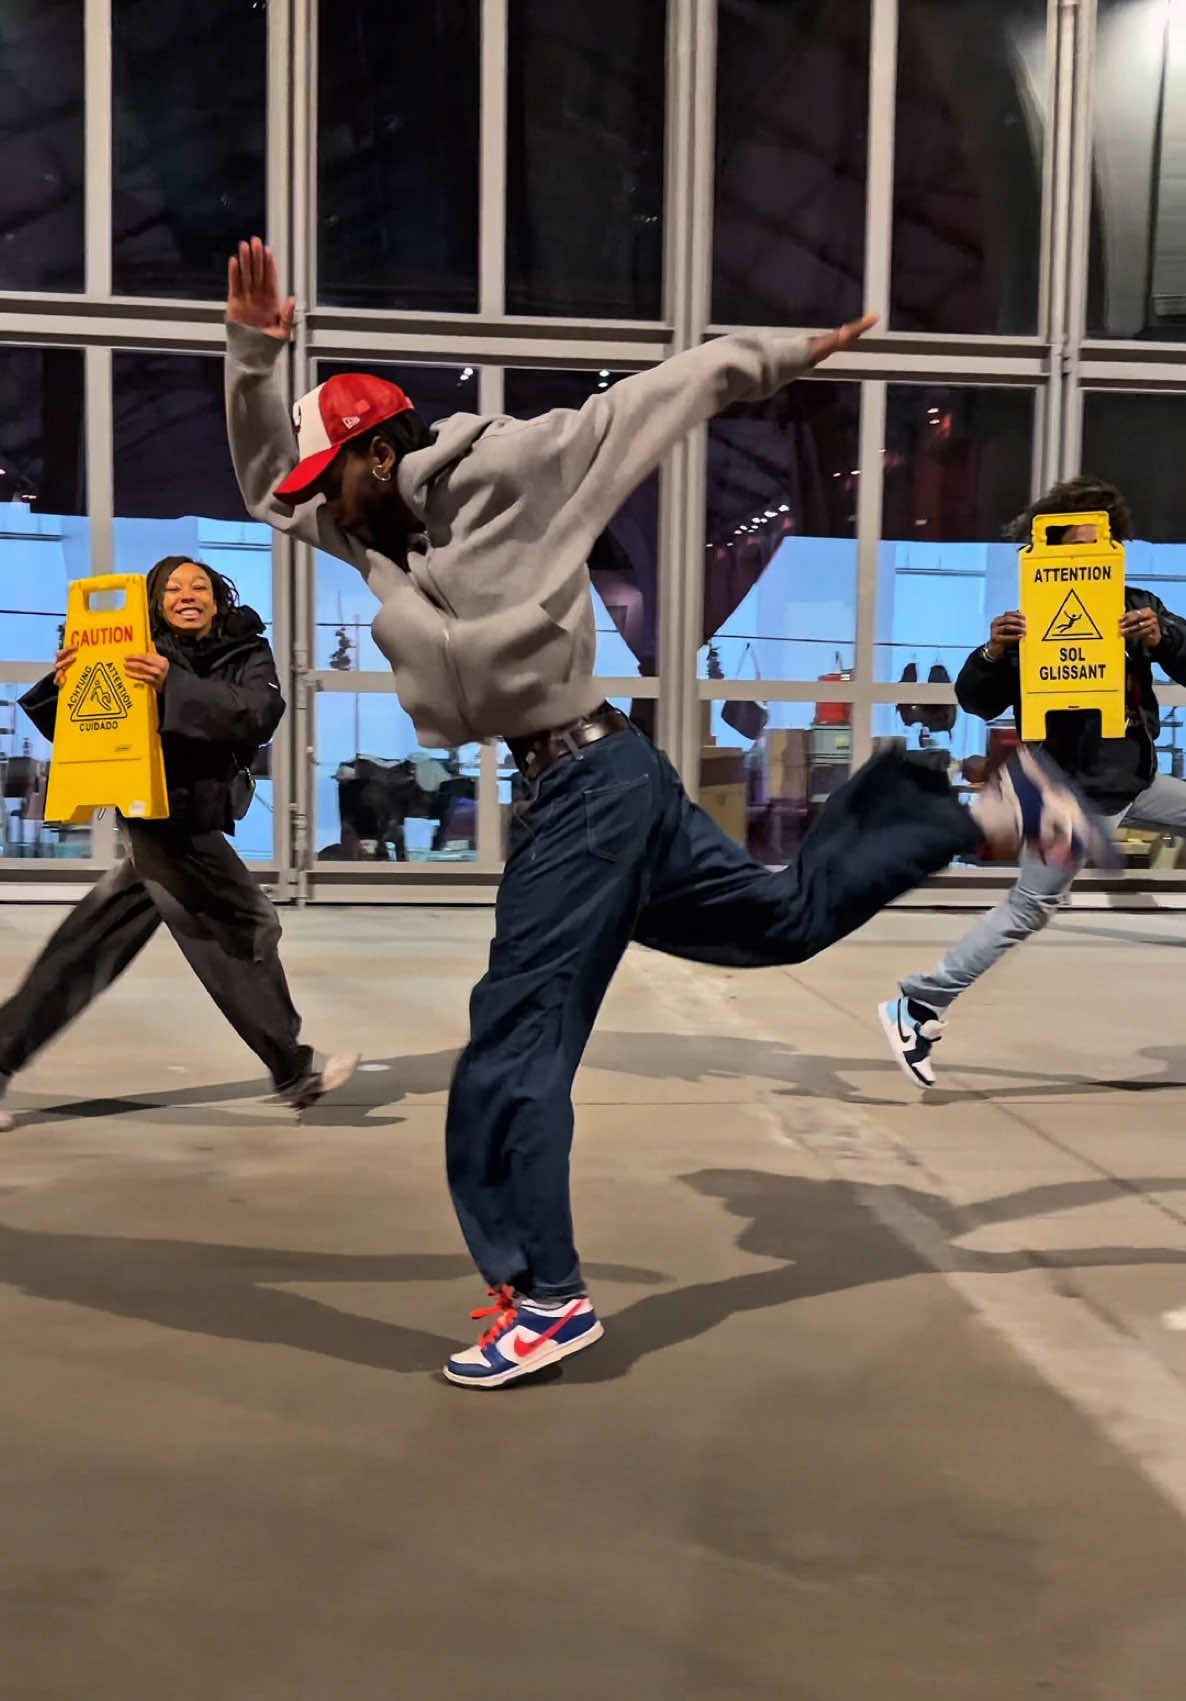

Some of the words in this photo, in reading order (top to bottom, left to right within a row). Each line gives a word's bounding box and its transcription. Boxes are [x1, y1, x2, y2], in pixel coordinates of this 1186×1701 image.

[1034, 565, 1111, 583] ATTENTION
[71, 625, 133, 647] CAUTION
[1059, 647, 1086, 662] SOL
[1039, 664, 1106, 681] GLISSANT
[67, 665, 93, 710] ACHTUNG
[105, 662, 133, 710] ATTENTION
[79, 721, 119, 732] CUIDADO
